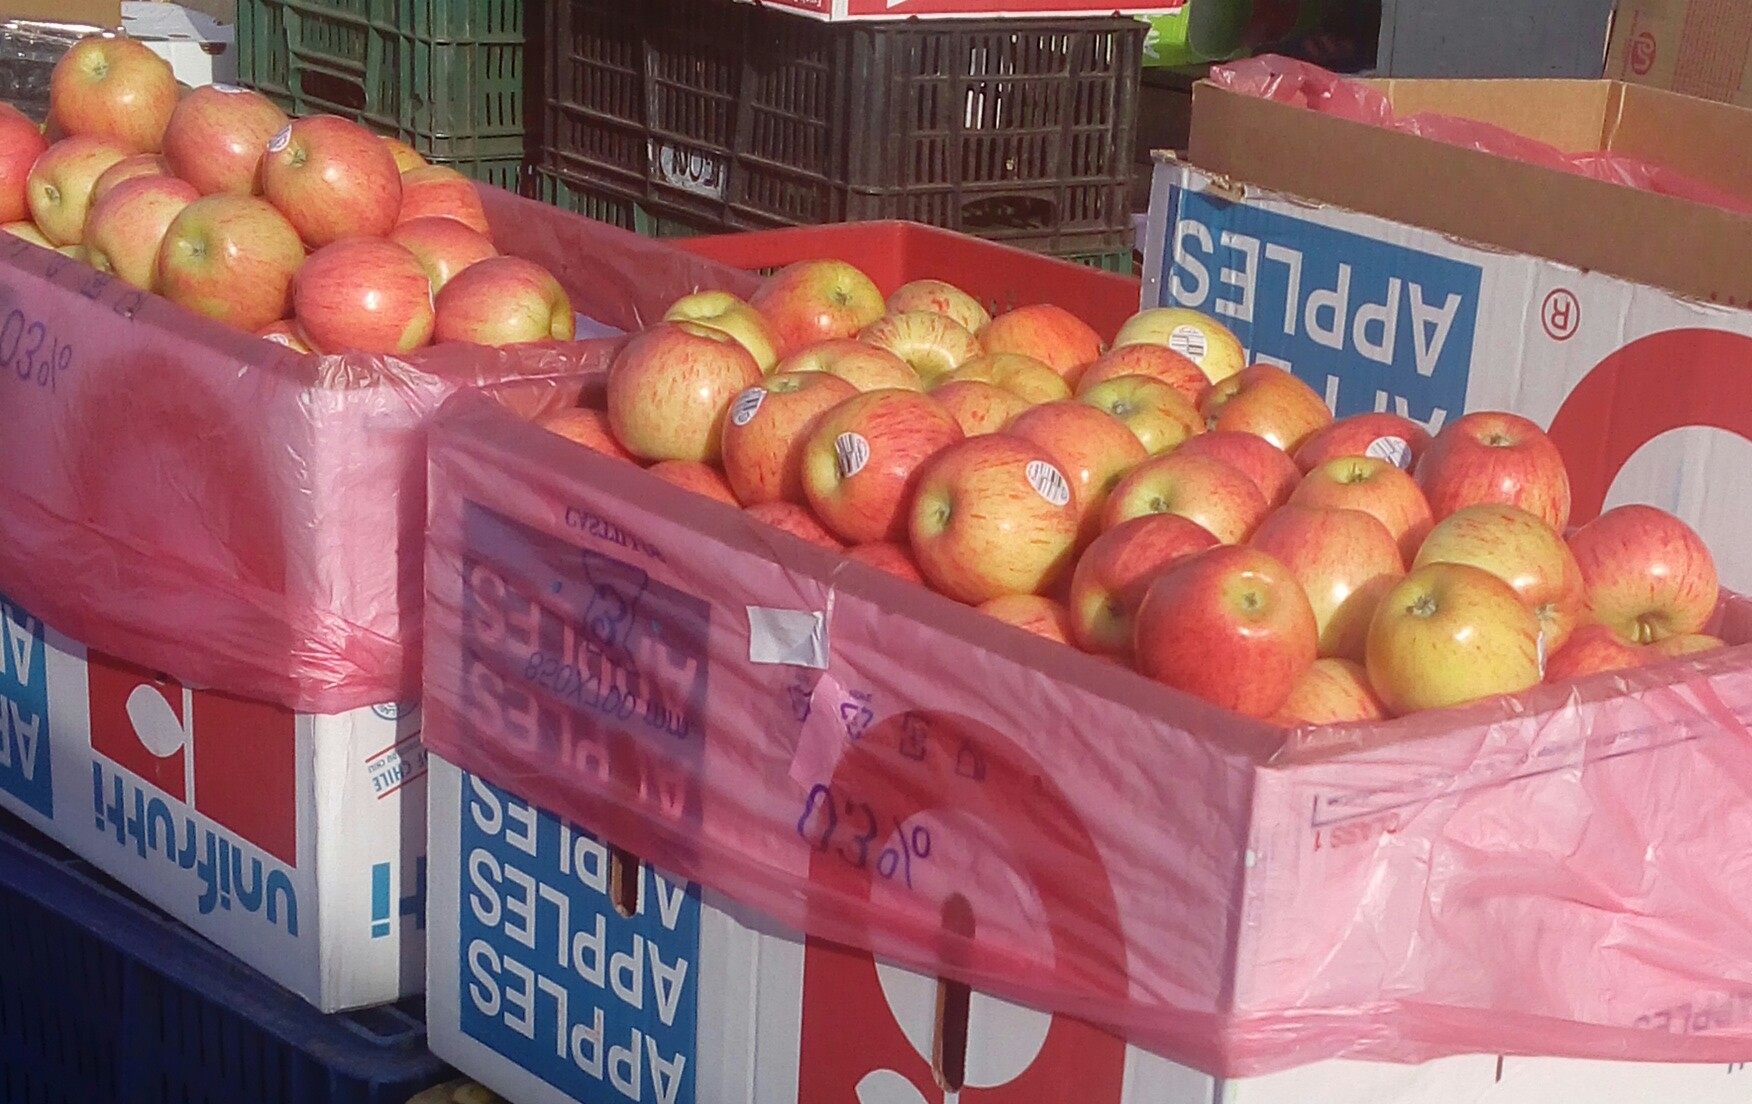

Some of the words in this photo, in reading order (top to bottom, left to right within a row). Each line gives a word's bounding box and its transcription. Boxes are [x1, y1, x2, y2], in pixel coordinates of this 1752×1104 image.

[1168, 219, 1463, 378] APPLES
[92, 759, 299, 938] unifrutti
[371, 760, 412, 792] CHILE
[470, 771, 689, 931] APLES
[468, 848, 689, 1027] APPLES
[467, 938, 687, 1104] APPLES
